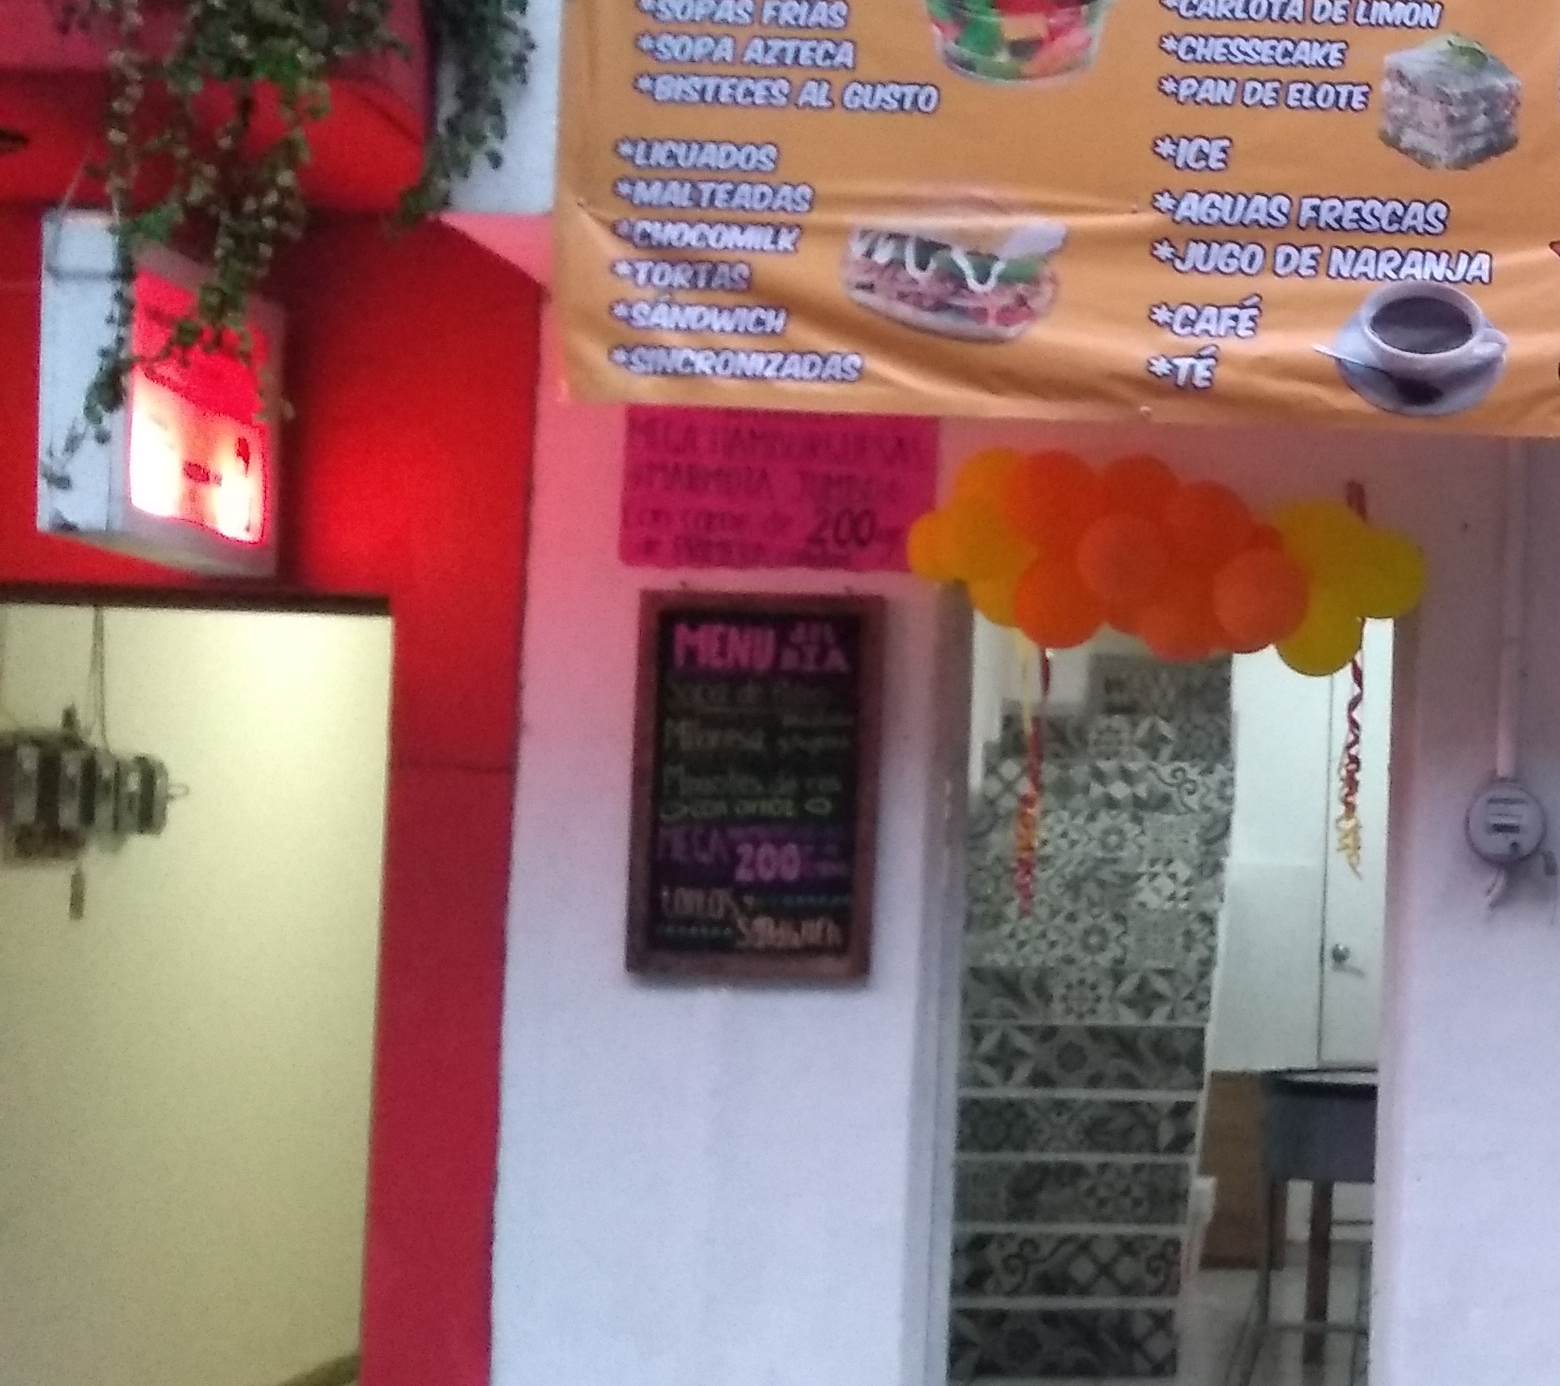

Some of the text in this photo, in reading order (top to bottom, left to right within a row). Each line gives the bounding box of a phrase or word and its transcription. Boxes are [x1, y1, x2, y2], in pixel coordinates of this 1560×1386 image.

[742, 36, 856, 69] AZTECA
[796, 78, 833, 109] AL
[841, 80, 940, 114] GUSTO
[1242, 76, 1282, 109] DE
[1286, 78, 1372, 112] ELOTE
[1297, 195, 1451, 236] FRESCAS
[1273, 244, 1322, 278] DE
[1327, 246, 1493, 285] NARANJA
[734, 842, 801, 882] 200
